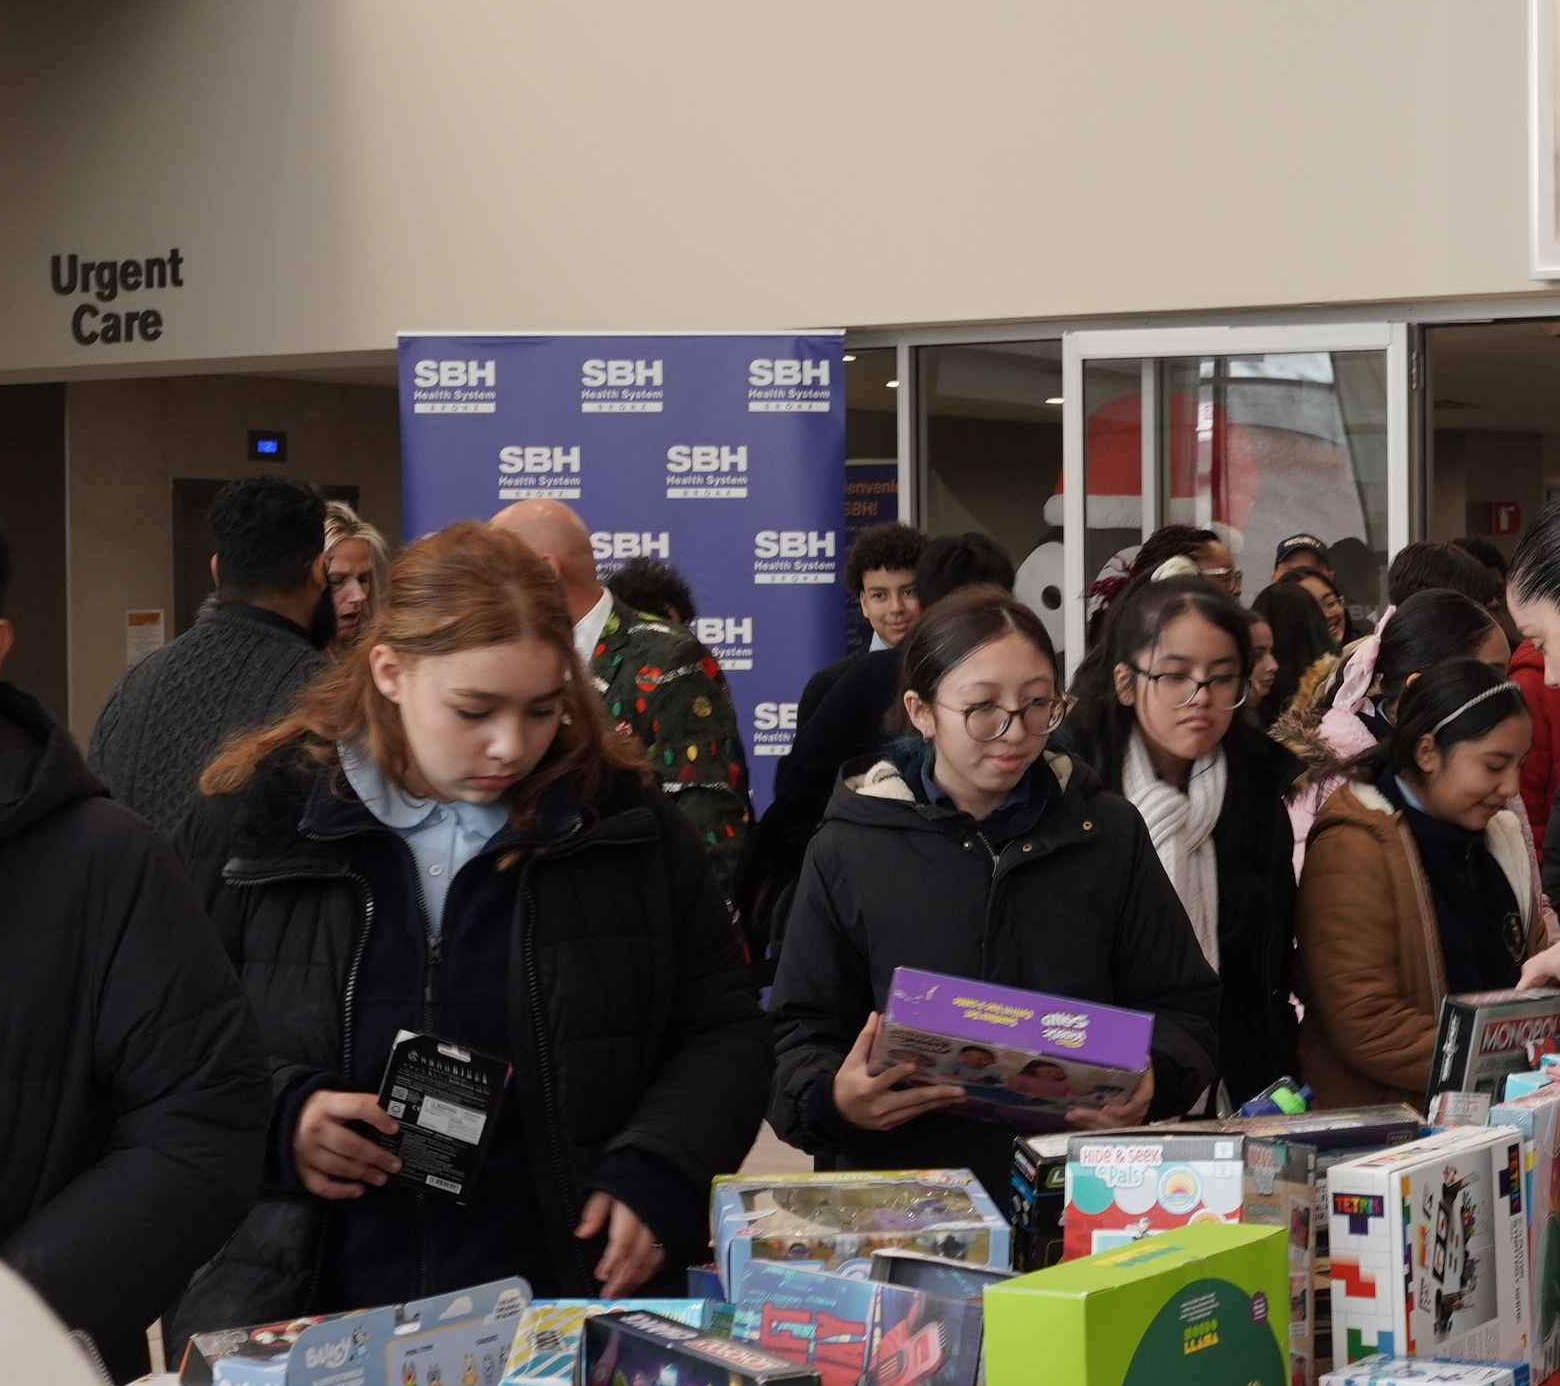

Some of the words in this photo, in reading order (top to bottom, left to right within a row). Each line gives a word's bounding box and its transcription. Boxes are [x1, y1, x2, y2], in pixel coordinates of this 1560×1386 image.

[51, 248, 184, 302] Urgent
[72, 303, 163, 346] Care
[414, 359, 496, 387] SBH
[581, 359, 663, 387] SBH
[748, 358, 830, 386] SBH
[414, 389, 451, 400] Health
[454, 389, 496, 401] System
[581, 389, 619, 400] Health
[622, 389, 664, 401] System
[748, 389, 785, 400] Health
[788, 389, 830, 401] System
[499, 445, 581, 473] SBH
[666, 445, 748, 473] SBH
[499, 475, 536, 486] Health
[538, 475, 581, 487] System
[666, 475, 704, 486] Health
[706, 475, 748, 487] System
[590, 531, 670, 559] SBH
[754, 530, 836, 558] SBH
[754, 560, 790, 571] Health
[793, 560, 835, 572] System
[690, 617, 753, 644] BH
[754, 702, 799, 731] SB
[1334, 1195, 1381, 1214] TETRIS
